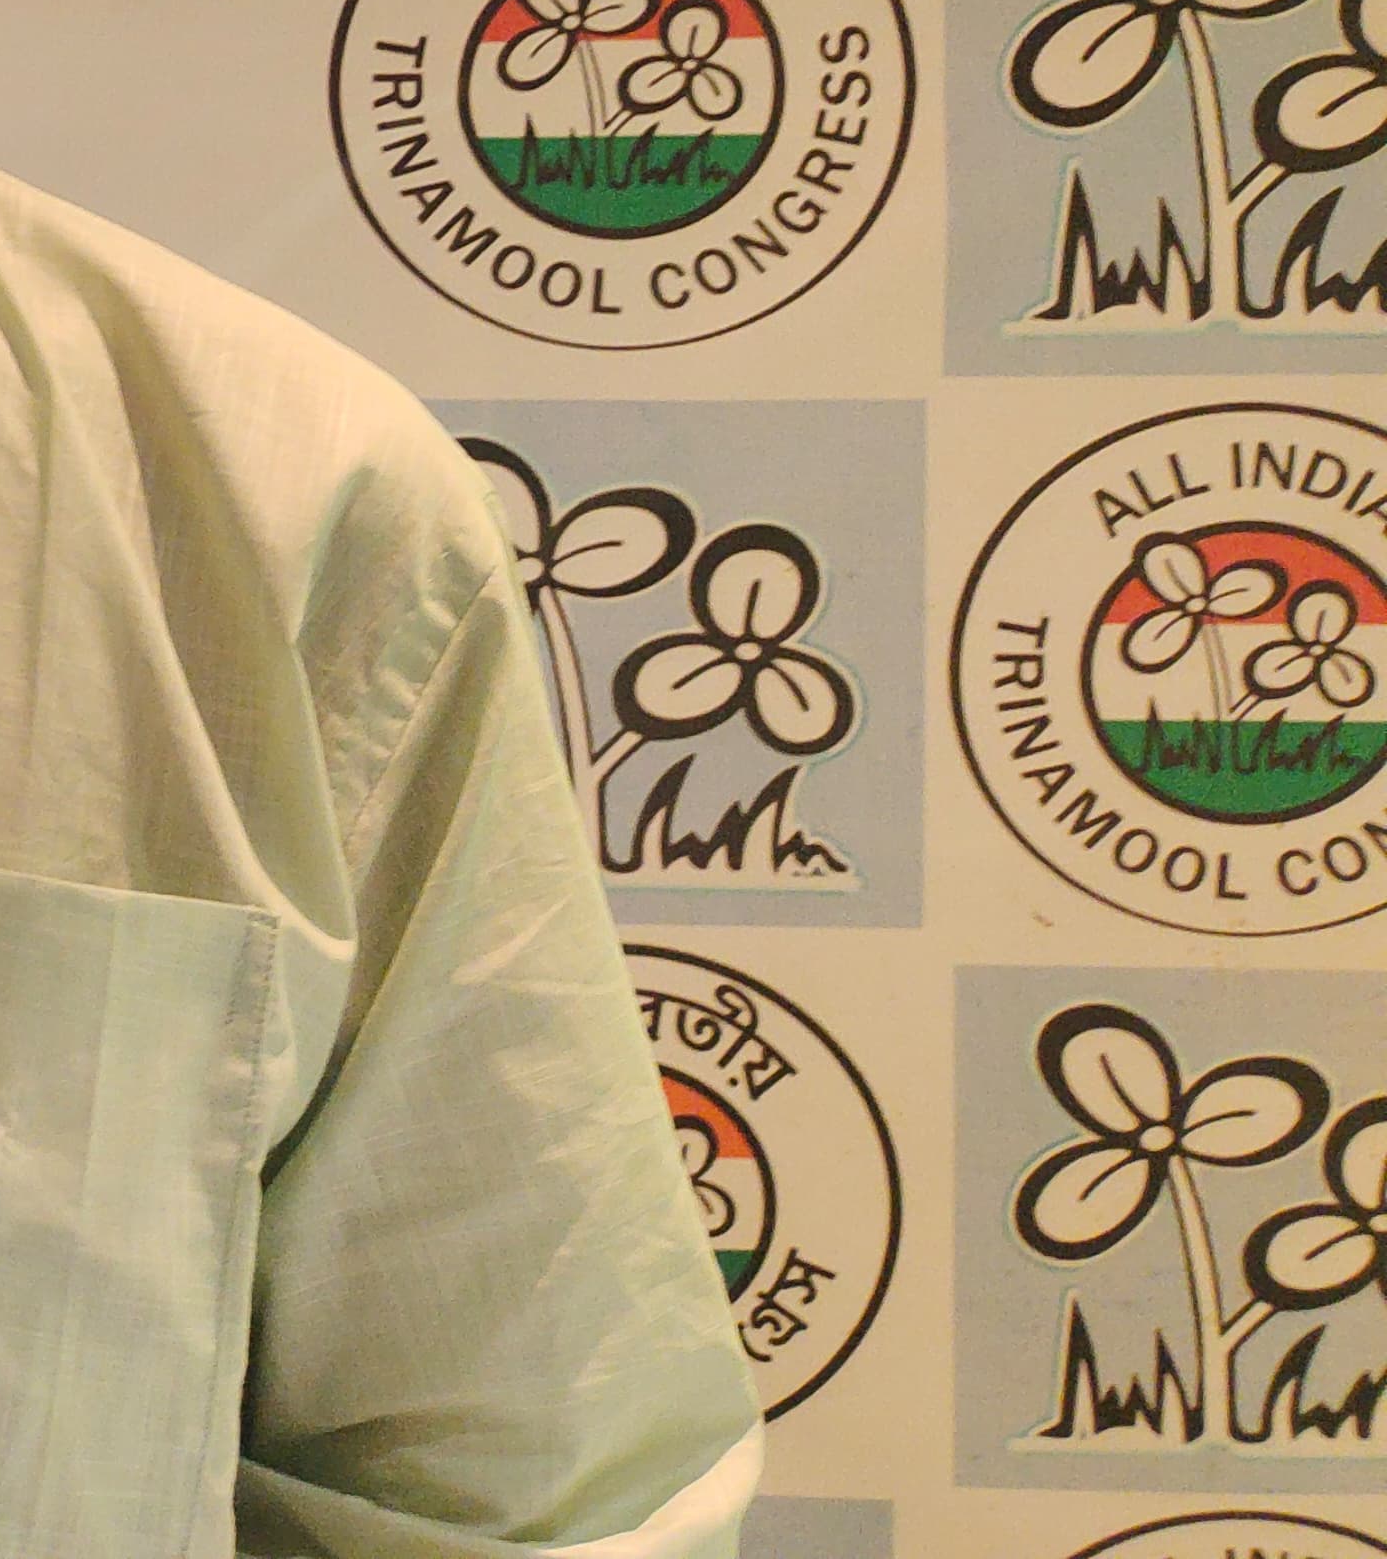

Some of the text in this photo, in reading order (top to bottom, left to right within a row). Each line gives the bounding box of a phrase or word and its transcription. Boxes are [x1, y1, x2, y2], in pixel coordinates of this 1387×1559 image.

[372, 24, 872, 314] TRINAMOOL CONGRESS
[1090, 452, 1211, 538] ALL
[992, 616, 1247, 901] TRINAMOOL
